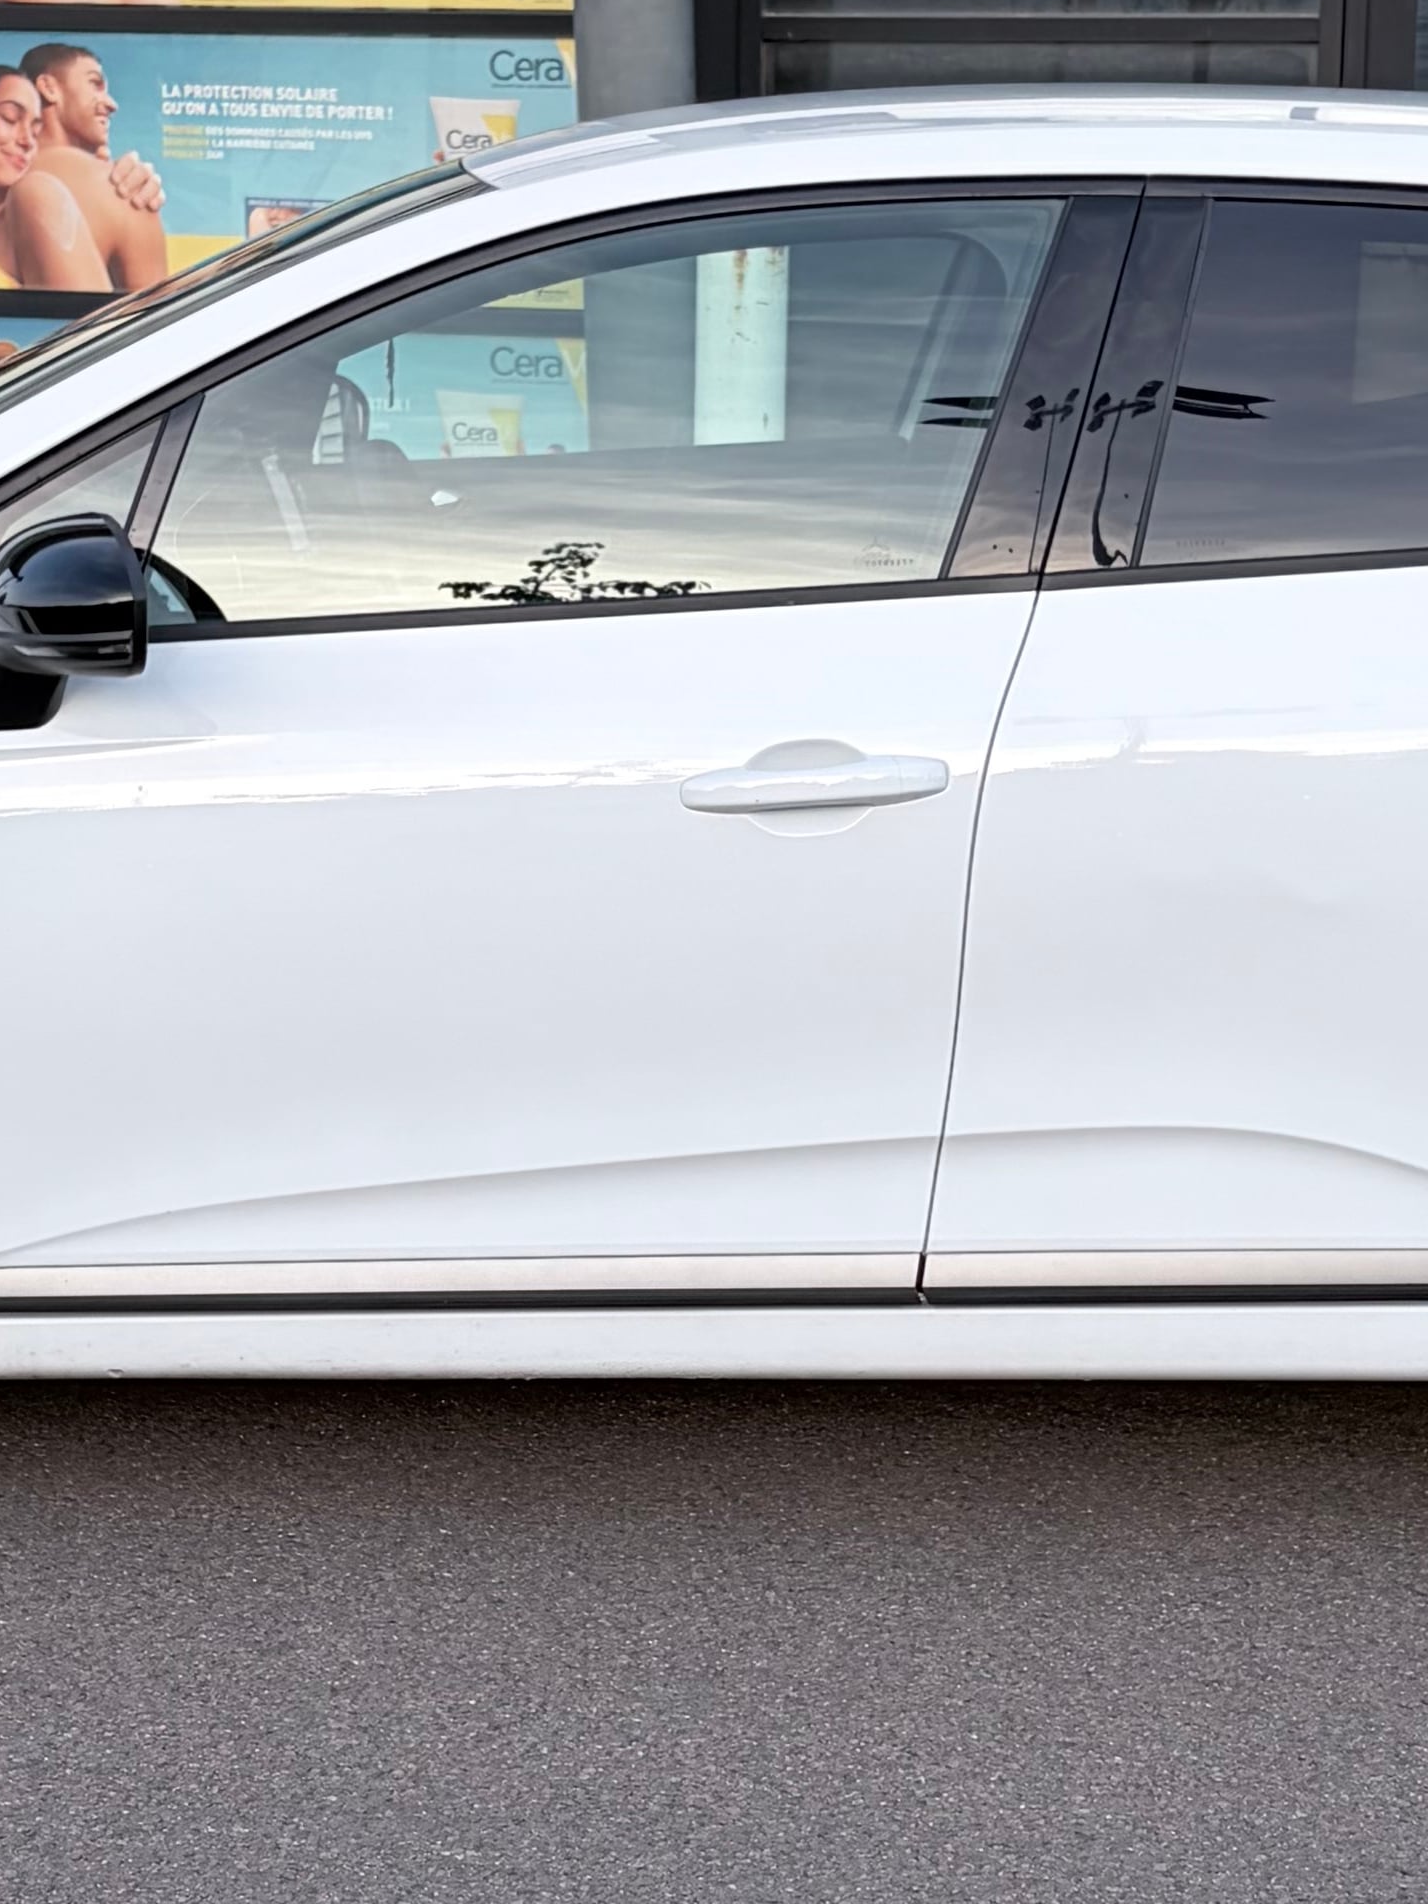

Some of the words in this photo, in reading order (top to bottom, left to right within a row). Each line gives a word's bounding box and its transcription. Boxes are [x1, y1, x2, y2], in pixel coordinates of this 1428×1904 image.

[161, 83, 181, 98] LA
[184, 84, 272, 100] PROTECTION
[276, 87, 338, 102] SOLAIRE
[162, 101, 206, 116] QU'ON
[223, 103, 258, 117] TOUS
[261, 103, 305, 118] ENVIE
[306, 104, 325, 119] DE
[327, 105, 384, 120] PORTER
